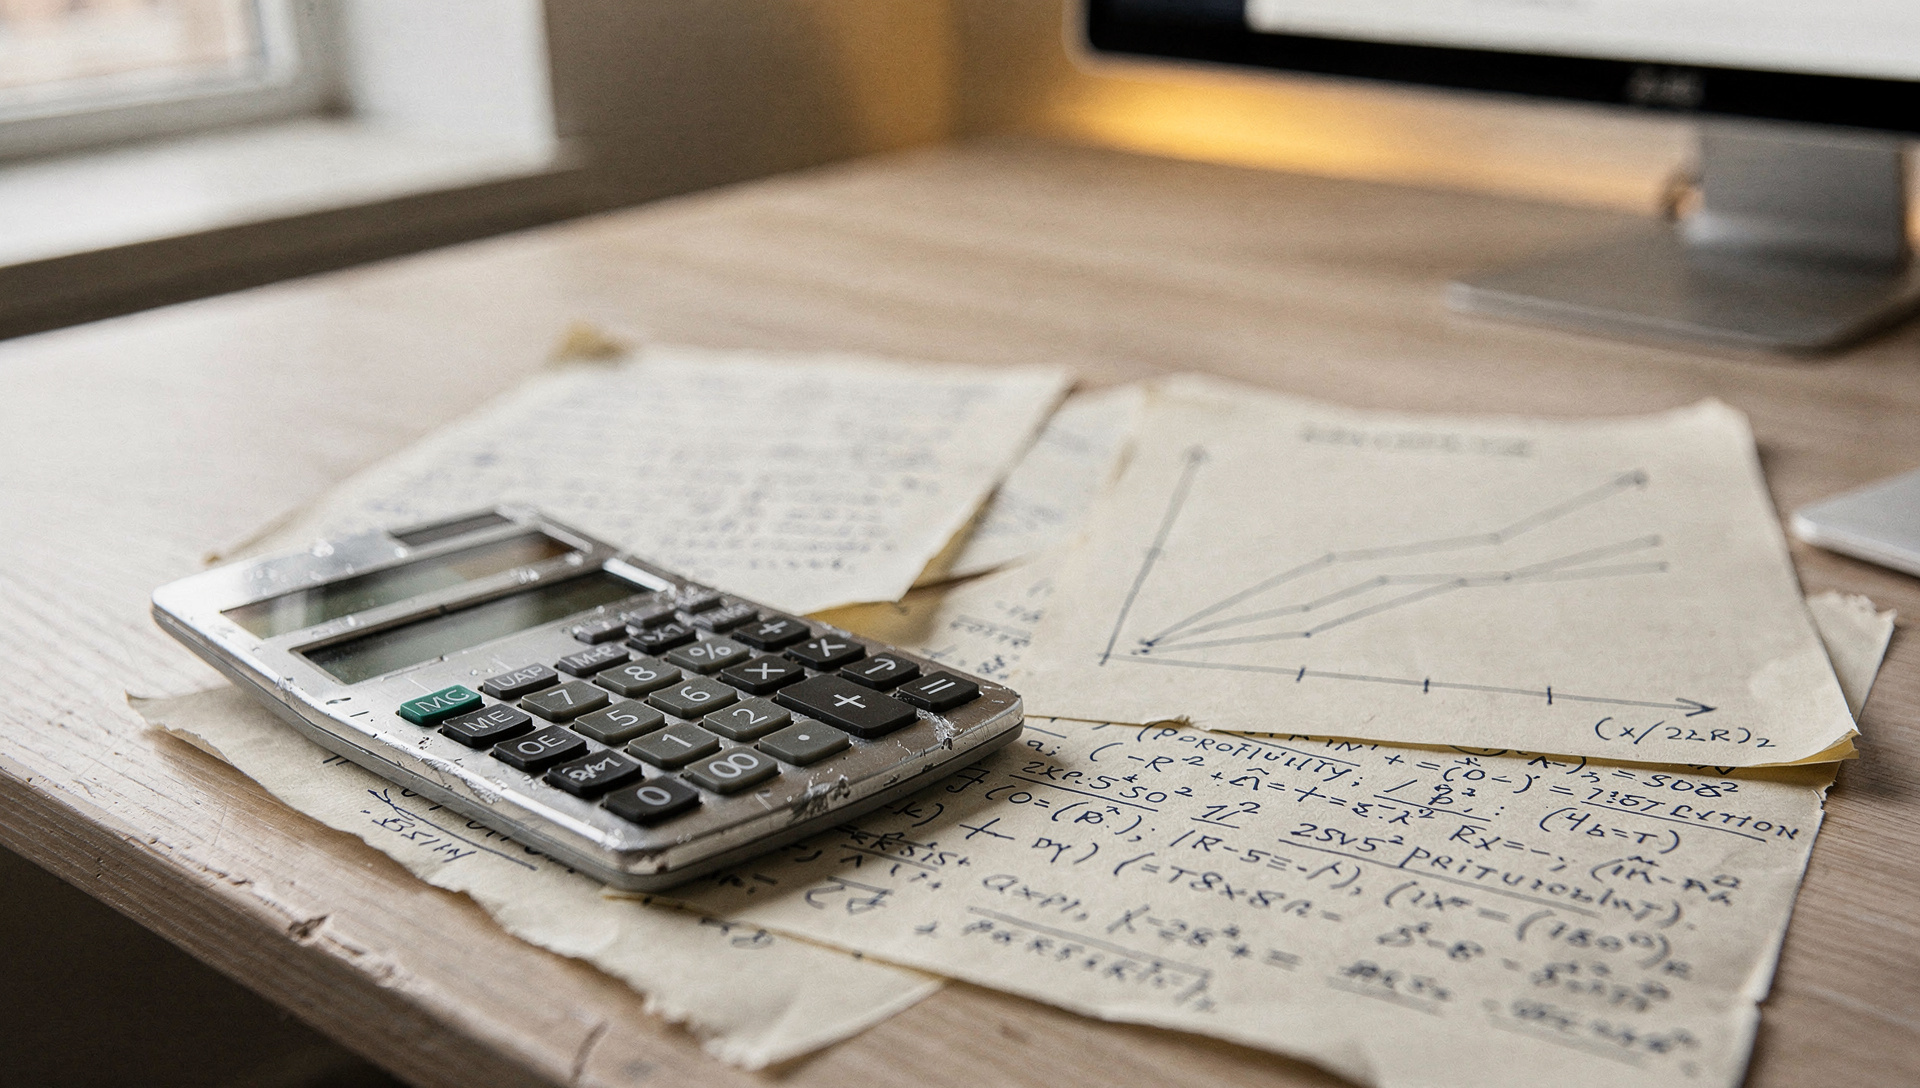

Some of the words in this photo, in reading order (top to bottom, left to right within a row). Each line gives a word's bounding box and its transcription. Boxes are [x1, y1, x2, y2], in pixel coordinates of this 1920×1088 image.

[689, 642, 732, 660] %
[624, 665, 657, 681] 8
[548, 689, 575, 706] 7
[680, 685, 711, 702] 6
[465, 709, 513, 732] ME
[606, 709, 639, 727] 5
[742, 708, 768, 724] 2
[662, 733, 693, 748] 1
